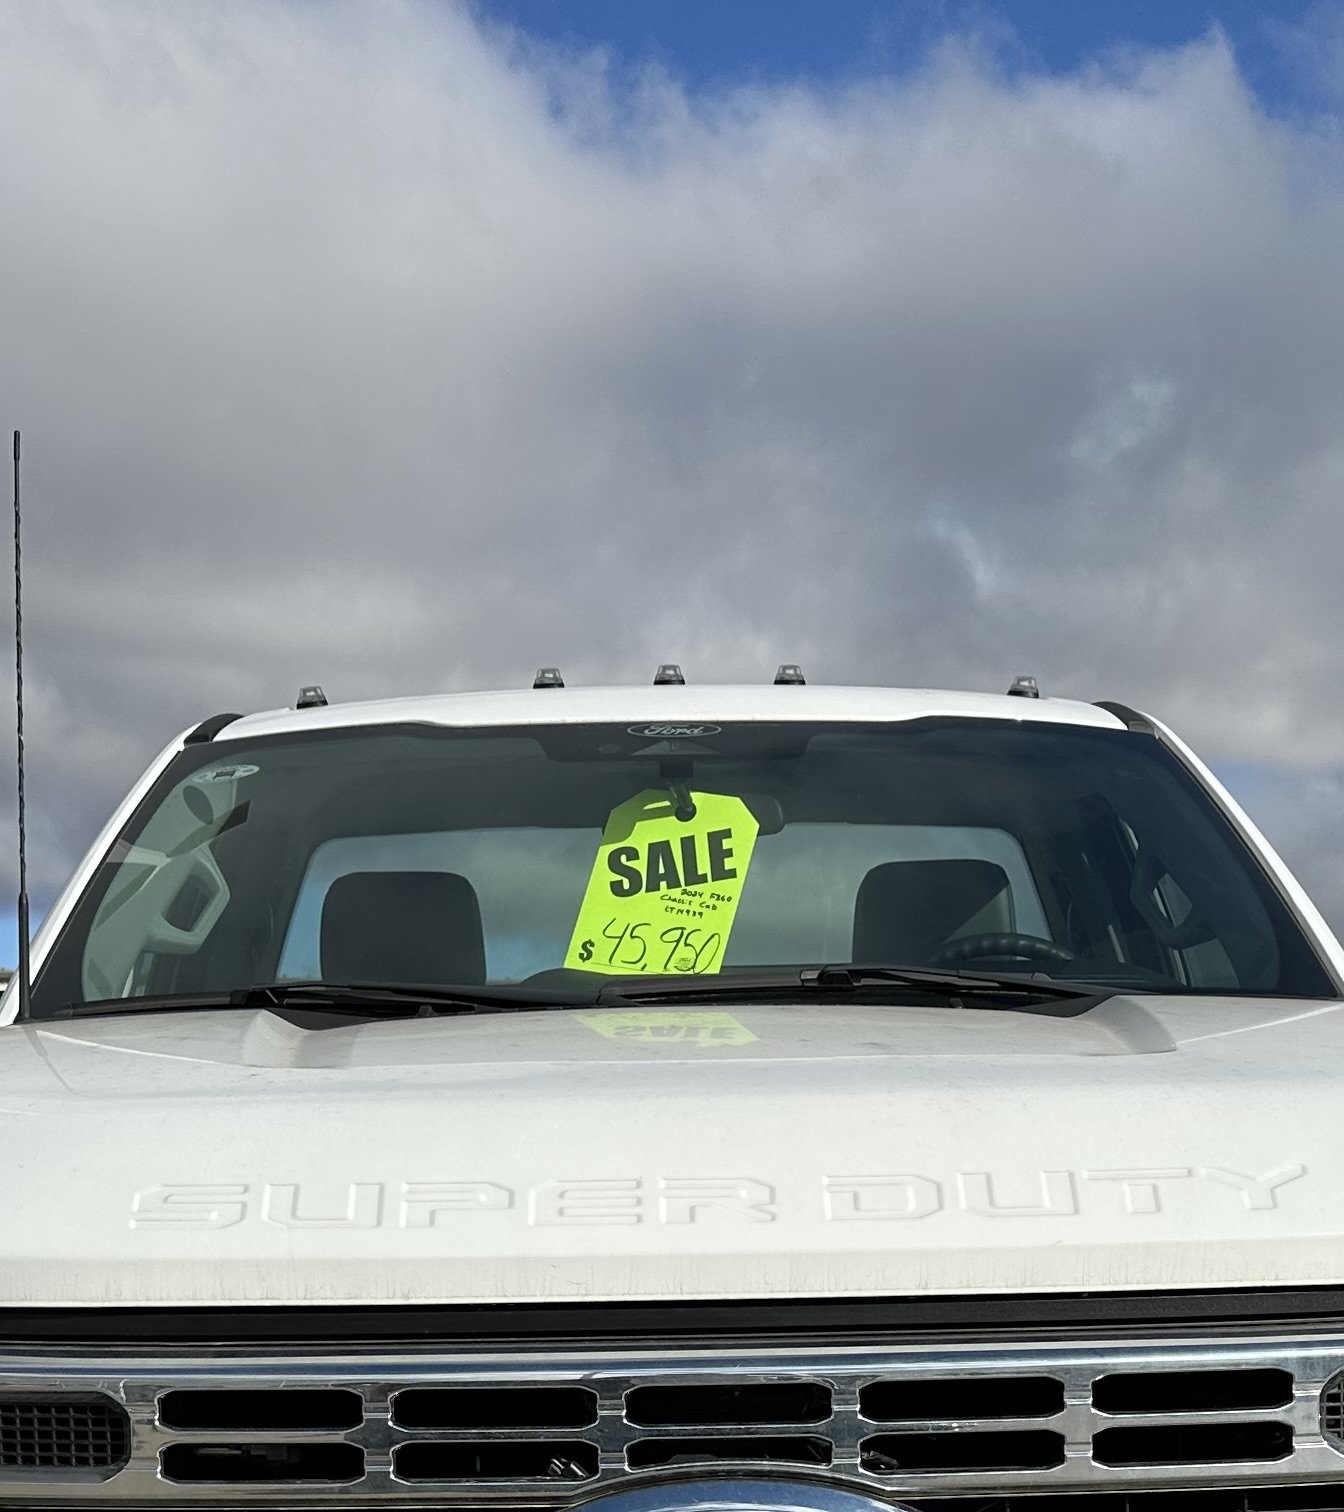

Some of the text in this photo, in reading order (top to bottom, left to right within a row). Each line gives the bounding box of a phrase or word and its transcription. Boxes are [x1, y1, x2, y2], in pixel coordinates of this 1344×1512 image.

[644, 725, 704, 735] Ford
[607, 828, 737, 898] SALE
[130, 1161, 1307, 1229] SUPER DUTY
